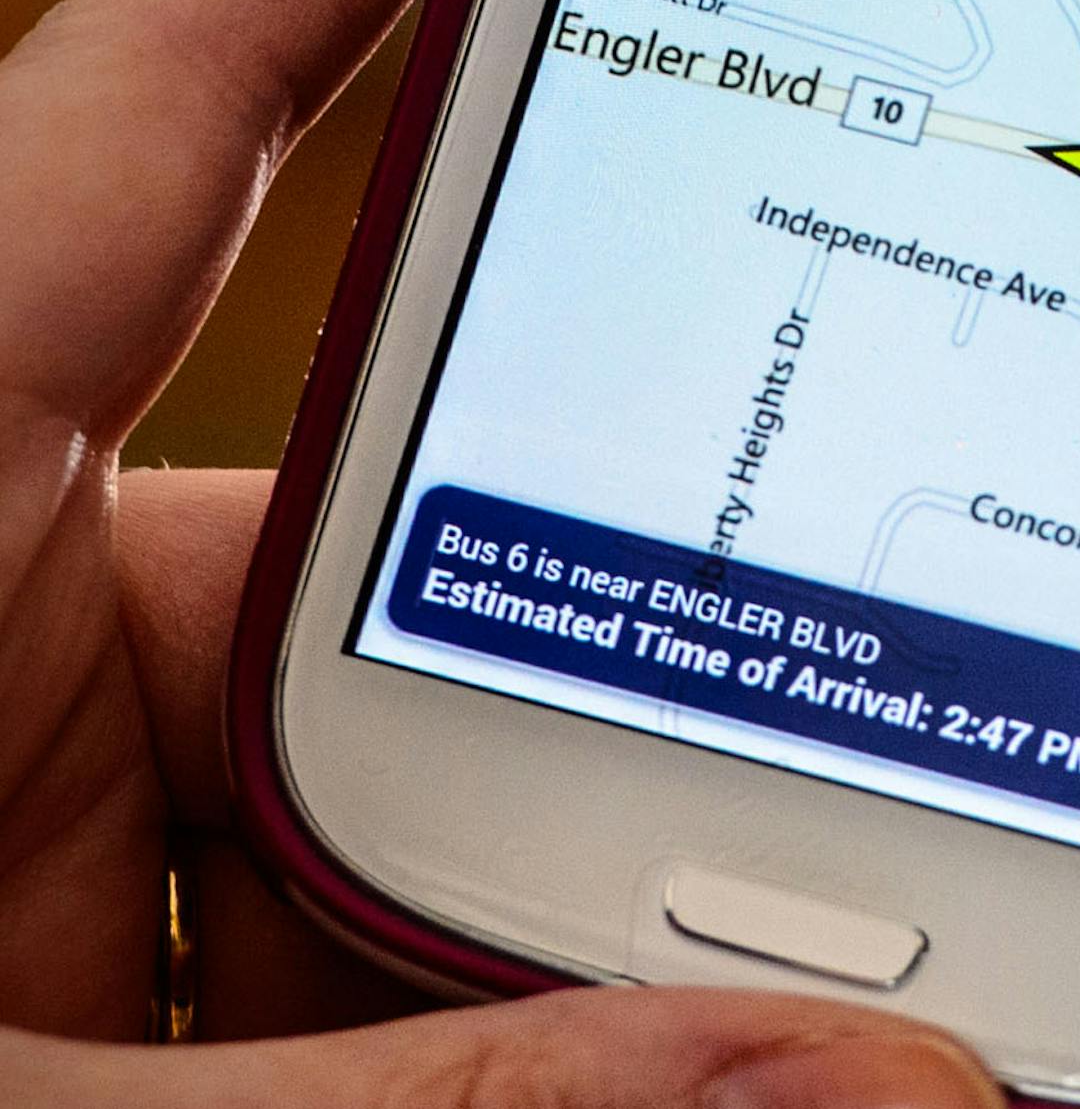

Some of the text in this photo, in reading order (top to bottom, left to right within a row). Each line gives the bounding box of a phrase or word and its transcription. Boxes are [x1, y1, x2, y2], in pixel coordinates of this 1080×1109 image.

[552, 10, 823, 108] Engler Blvd
[873, 96, 904, 125] 10
[754, 196, 1068, 313] Independence Ave
[727, 358, 796, 485] Heights
[773, 306, 811, 351] Dr
[436, 522, 883, 667] Bus 6 is near ENGLER BLVD
[420, 566, 626, 650] Estimated
[631, 620, 732, 678] Time
[737, 655, 788, 692] of
[785, 664, 934, 733] Arrival:
[937, 703, 1036, 758] 2:47
